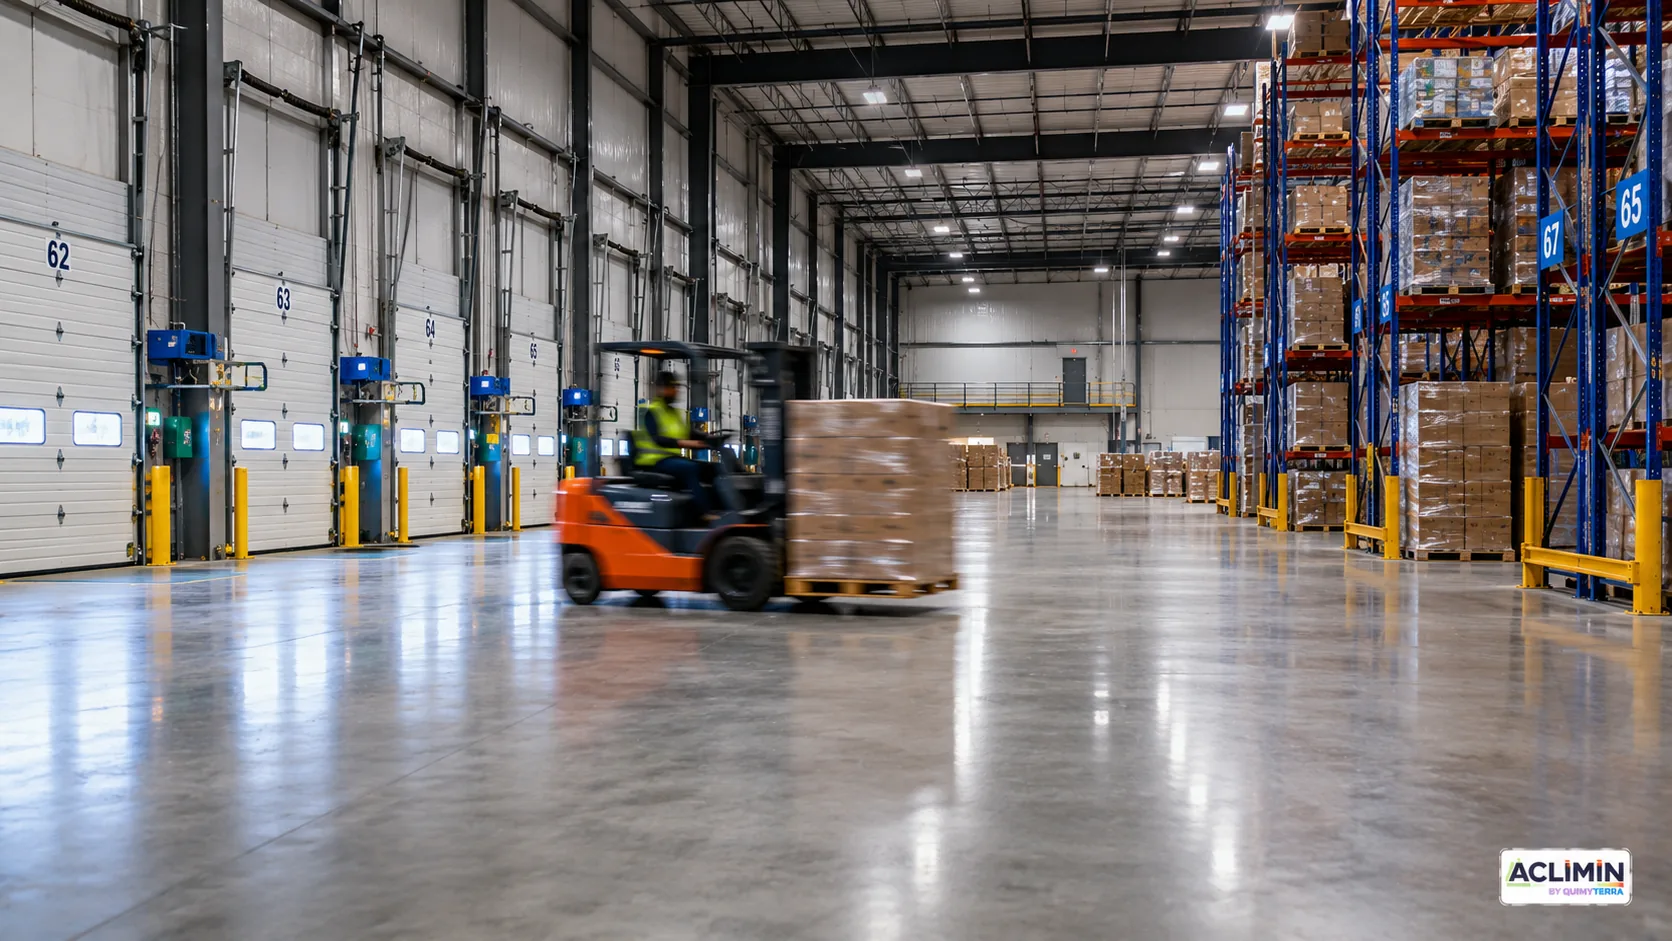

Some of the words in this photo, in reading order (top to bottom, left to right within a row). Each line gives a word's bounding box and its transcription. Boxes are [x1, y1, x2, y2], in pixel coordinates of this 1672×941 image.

[1621, 182, 1642, 229] 65
[47, 239, 70, 270] 62
[1543, 221, 1560, 259] 67
[276, 286, 290, 311] 63
[425, 318, 435, 339] 64
